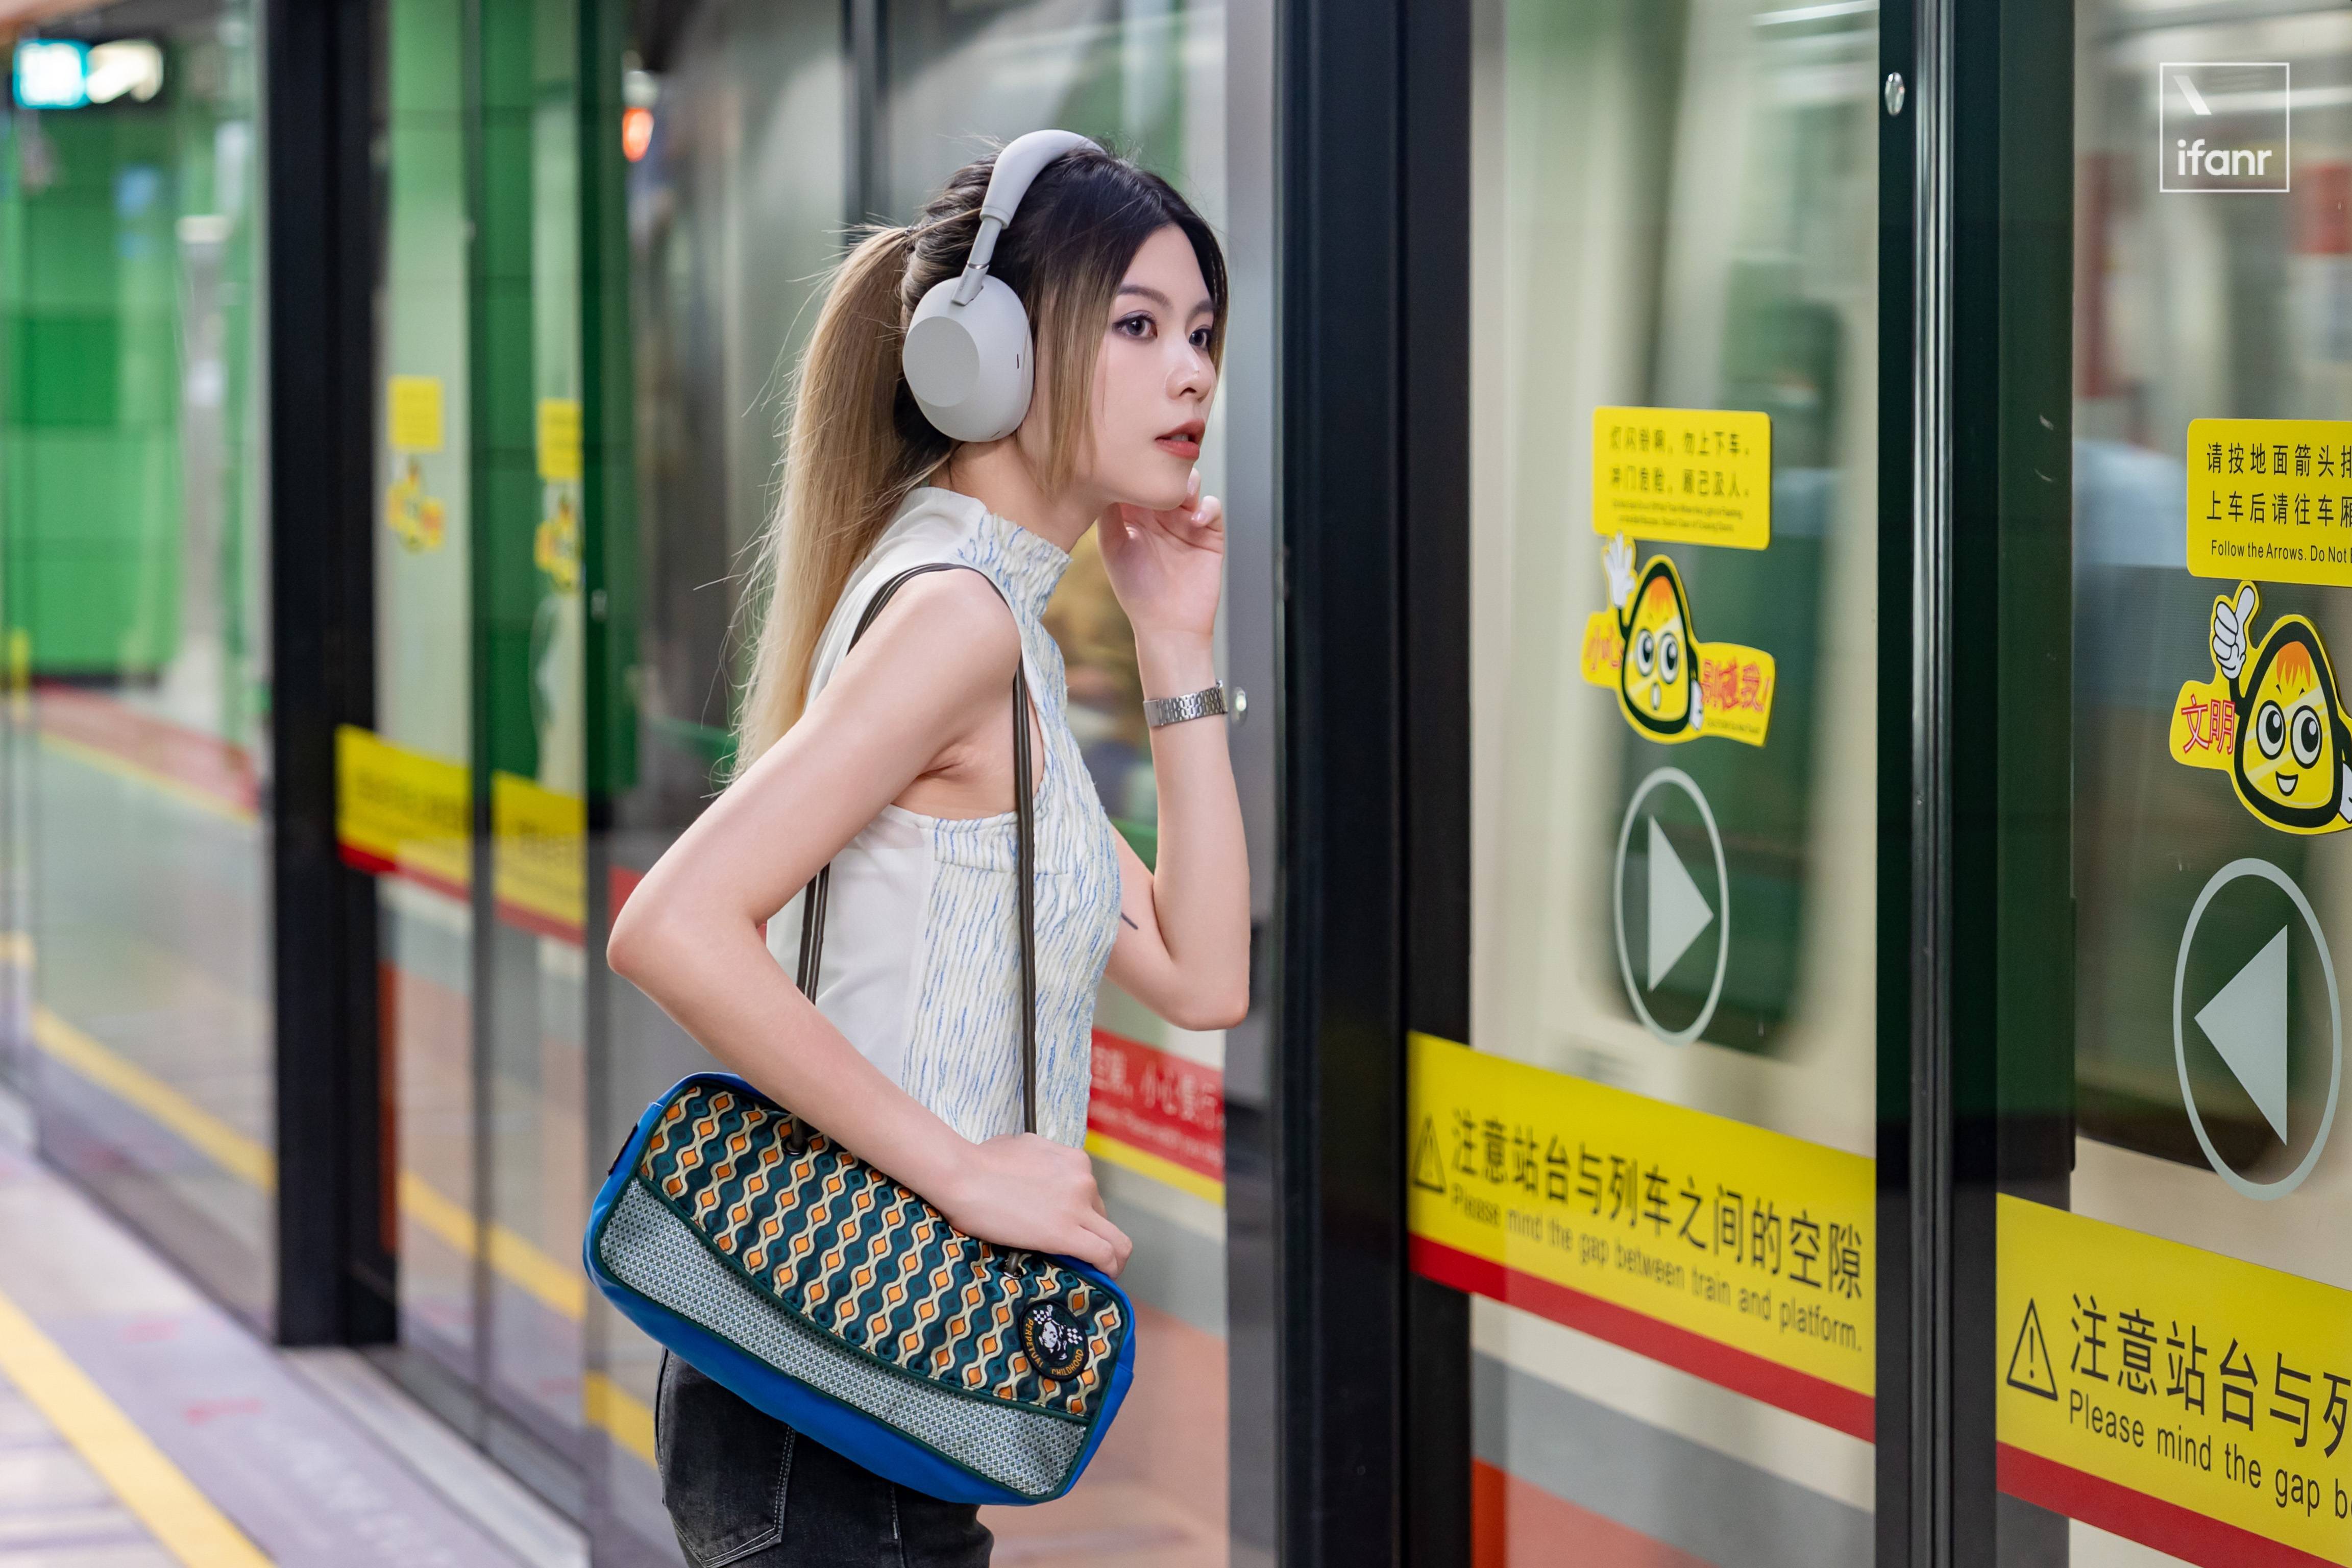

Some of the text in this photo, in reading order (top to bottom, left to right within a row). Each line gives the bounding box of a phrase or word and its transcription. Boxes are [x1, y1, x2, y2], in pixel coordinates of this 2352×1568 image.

[2207, 491, 2352, 528] 上车后请往车厢
[2212, 540, 2244, 556] Follow
[2248, 542, 2263, 558] the
[2266, 543, 2306, 560] Arrows.
[2311, 545, 2324, 562] Do
[2329, 546, 2347, 564] Not
[2181, 694, 2235, 755] 文明
[1452, 1108, 1861, 1298] 注意站台与列车之间的空隙
[1451, 1182, 1862, 1352] Please mind the gap between train and platform.
[1025, 1318, 1084, 1376] PERPETUAL CHILDHOOD
[2070, 1388, 2144, 1448] Please
[2157, 1425, 2211, 1472] mind
[2224, 1442, 2262, 1489] the
[2275, 1468, 2320, 1517] gap
